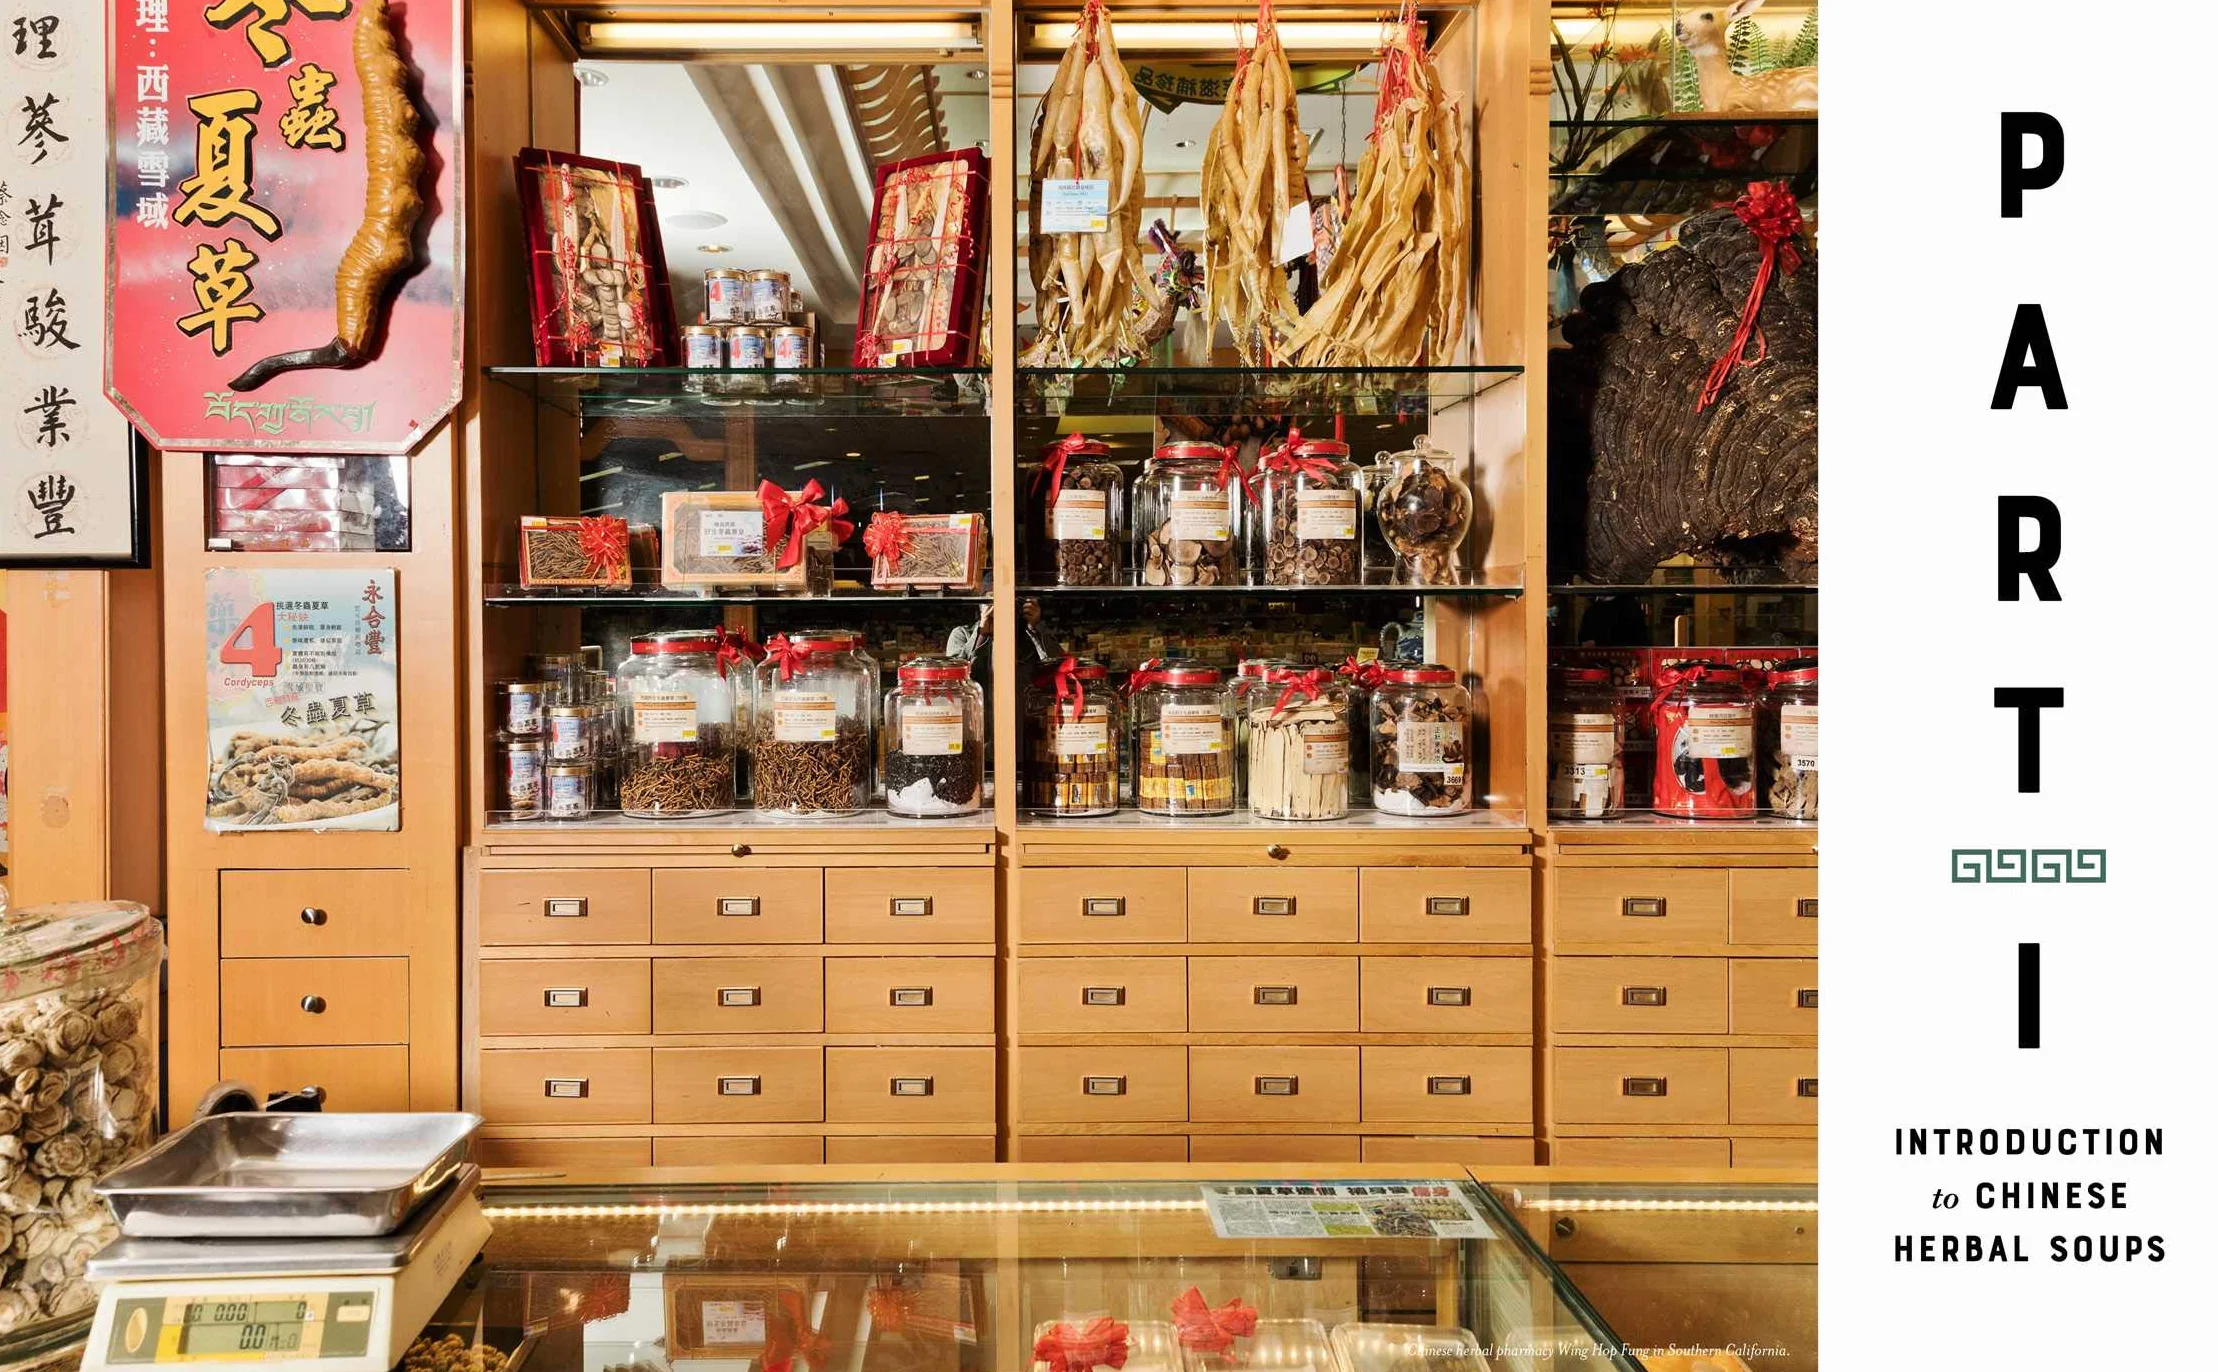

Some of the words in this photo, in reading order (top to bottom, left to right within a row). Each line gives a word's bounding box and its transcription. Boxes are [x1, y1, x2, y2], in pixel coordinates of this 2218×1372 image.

[220, 601, 282, 678] 4
[223, 677, 275, 688] Cordyceps
[280, 691, 377, 727] 冬蟲夏草
[1797, 759, 1815, 768] 3570
